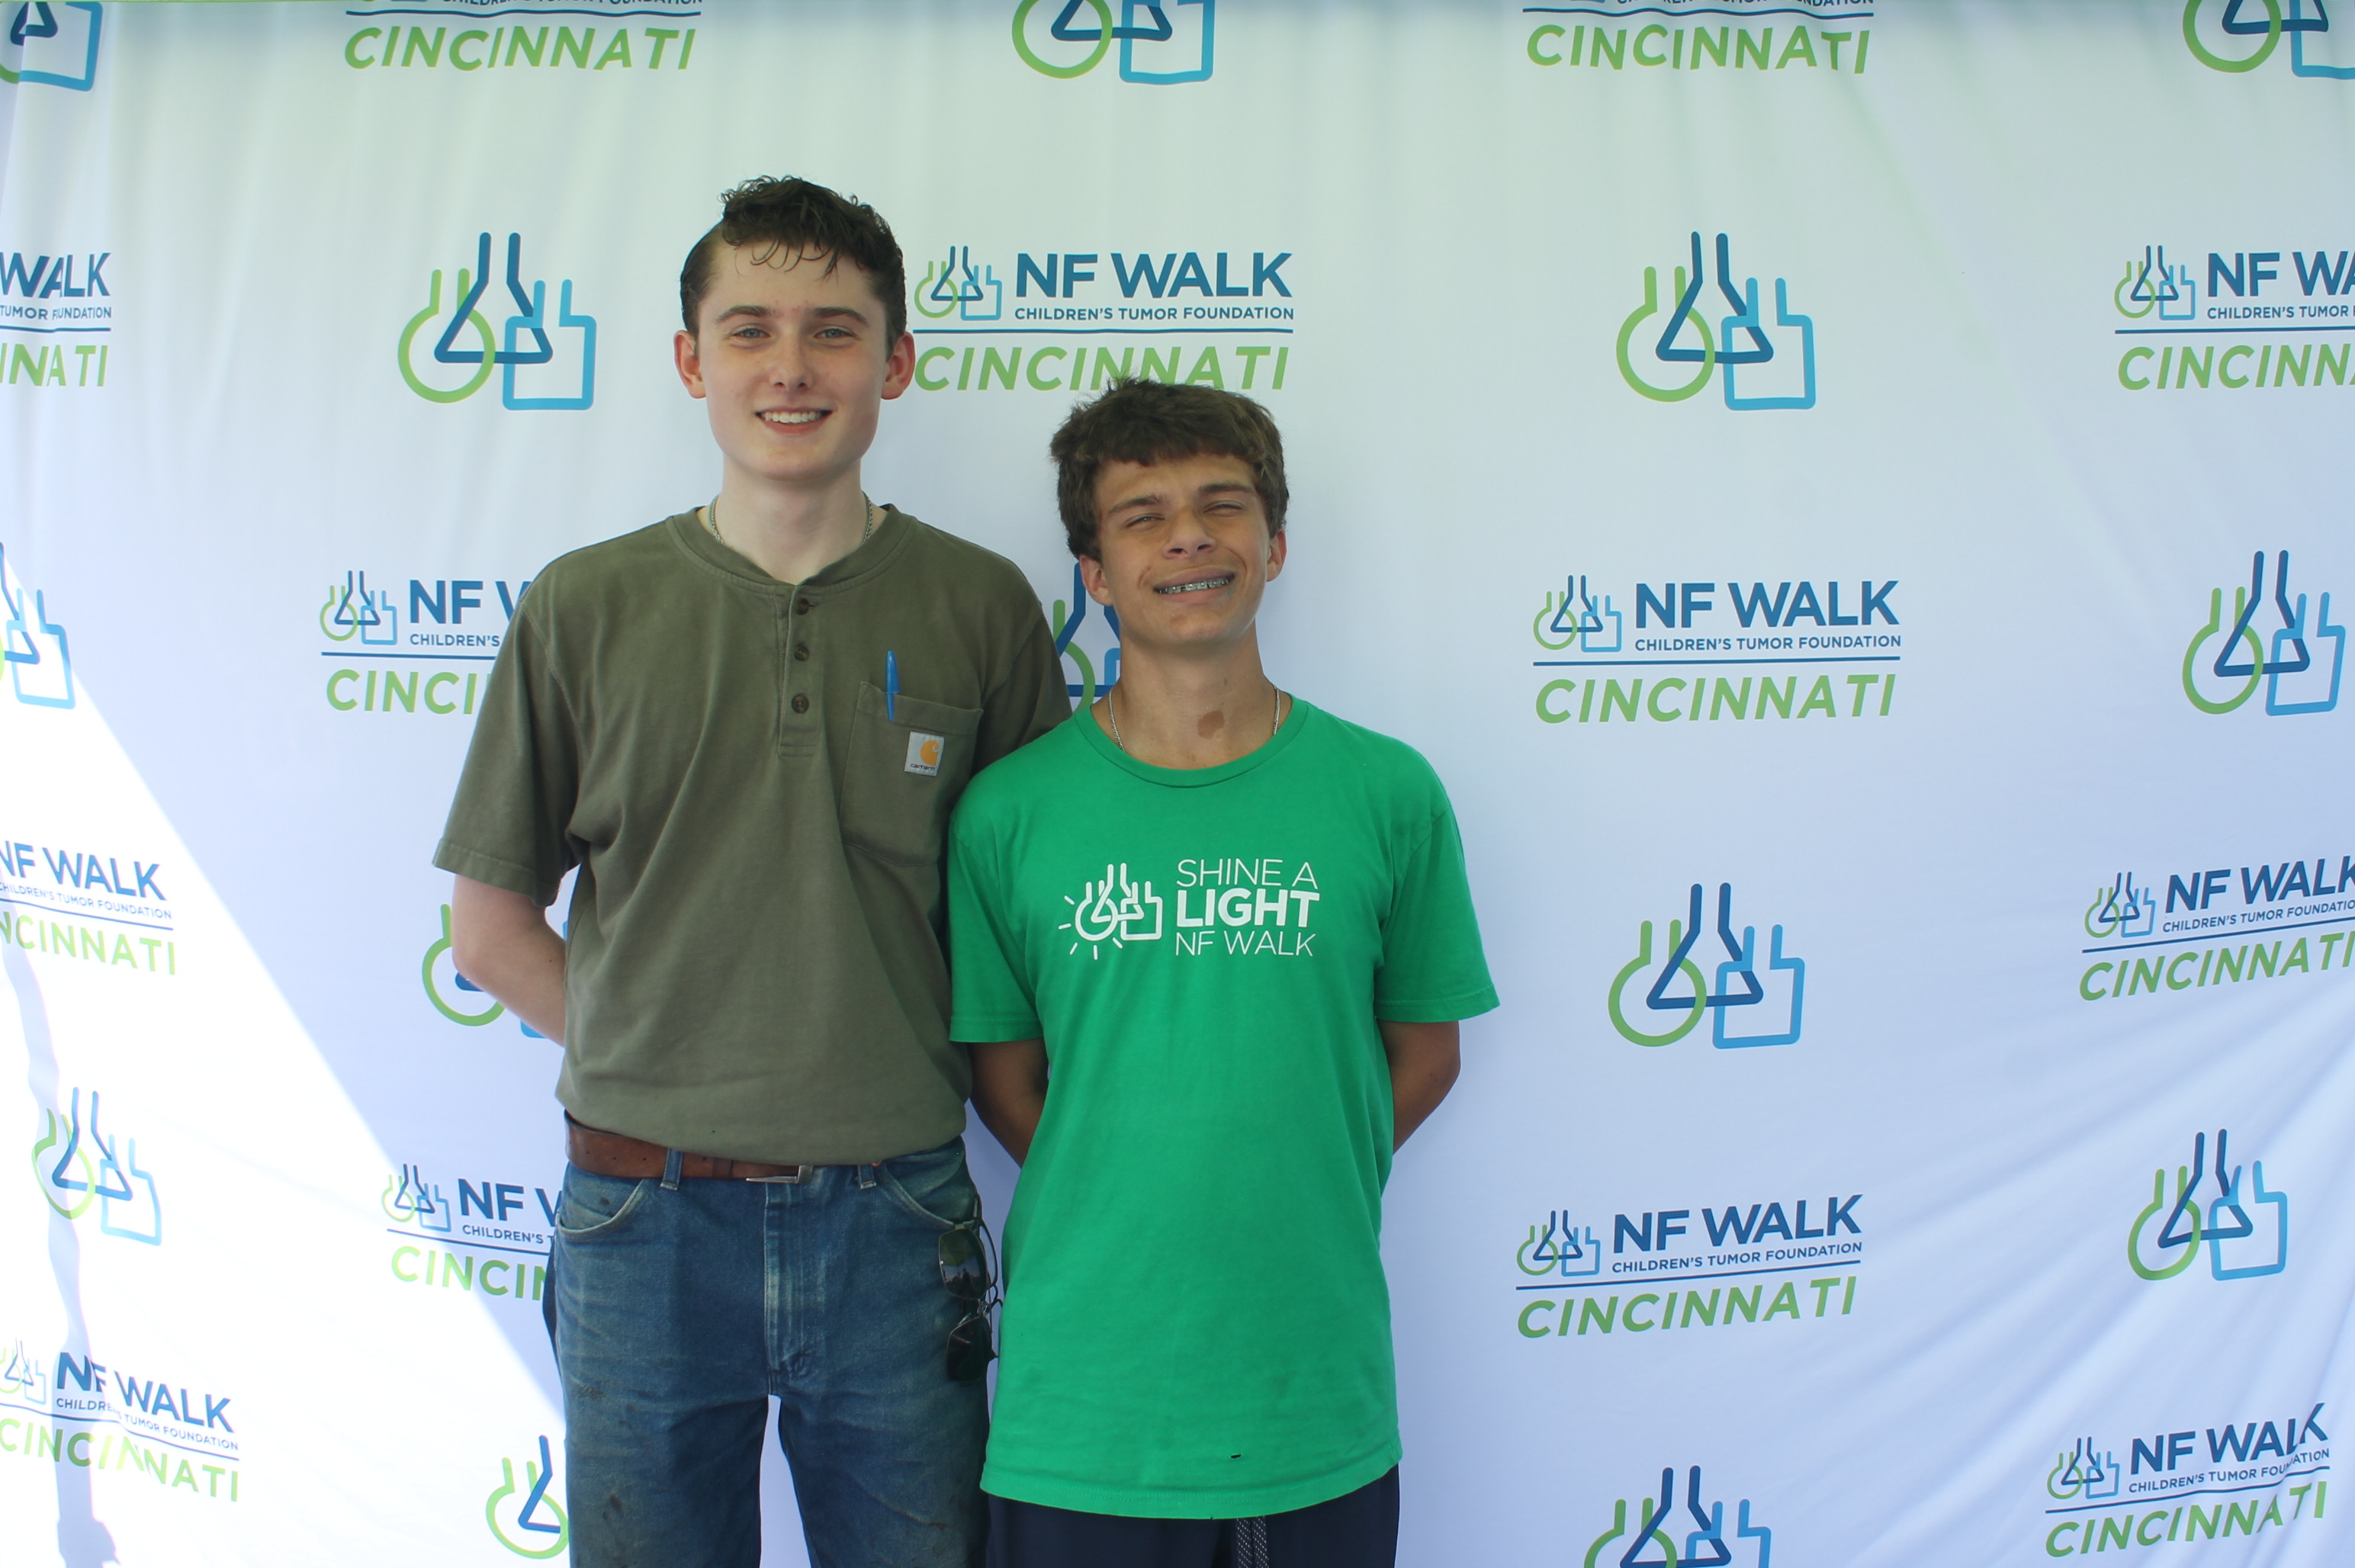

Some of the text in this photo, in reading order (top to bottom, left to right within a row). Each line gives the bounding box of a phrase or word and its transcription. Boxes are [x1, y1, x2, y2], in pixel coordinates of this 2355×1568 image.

[344, 26, 696, 71] CINCINNATI
[1527, 24, 1870, 74] CINCINNATI
[0, 252, 111, 299] WALK
[1016, 252, 1293, 298] NF WALK
[2208, 252, 2280, 297] NF
[0, 304, 111, 320] TUMOR FUNDATION
[1015, 307, 1294, 321] CHILDREN'S TUMOR FOUNDATION
[2207, 305, 2349, 320] CHILDREN'S TUMOR
[915, 346, 1289, 390] CINCINNATI
[2118, 343, 2355, 390] CINCINN
[410, 579, 484, 624] NF
[1635, 580, 1900, 628] NF WALK
[410, 633, 500, 647] CHILDREN'S
[1634, 635, 1901, 651] CHILDREN'S TUMOR FOUNDATION
[326, 669, 494, 715] CINCI
[1535, 673, 1896, 724] CINCINNATI
[41, 847, 167, 901] WALK
[1176, 858, 1318, 889] SHINE A
[2164, 856, 2355, 914] NF WALK
[56, 892, 94, 908] TUMOR
[98, 899, 172, 920] FOUNDATION
[1177, 888, 1320, 927] LIGHT
[2162, 914, 2237, 933] CHILDREN'S
[2241, 908, 2283, 923] TUMOR
[1176, 930, 1316, 956] NF WALK
[2080, 930, 2355, 1001] CINCINNATI
[458, 1178, 525, 1221] NF
[462, 1224, 544, 1244] CHILDREN'S
[1614, 1194, 1863, 1254] NF WALK
[1611, 1242, 1862, 1274] CHILDREN'S TUMOR FOUNDATION
[1518, 1276, 1857, 1338] CINCINNATI
[56, 1351, 235, 1433] NF WALK
[124, 1414, 161, 1432] TUMOR
[163, 1425, 238, 1451] FOUNDATION
[2130, 1403, 2328, 1475] NF WALK
[0, 1418, 238, 1502] CINCINNATI
[2128, 1473, 2205, 1493] CHILDREN'S
[2208, 1468, 2257, 1483] TUMOR
[2045, 1481, 2327, 1557] CINCINNATI
